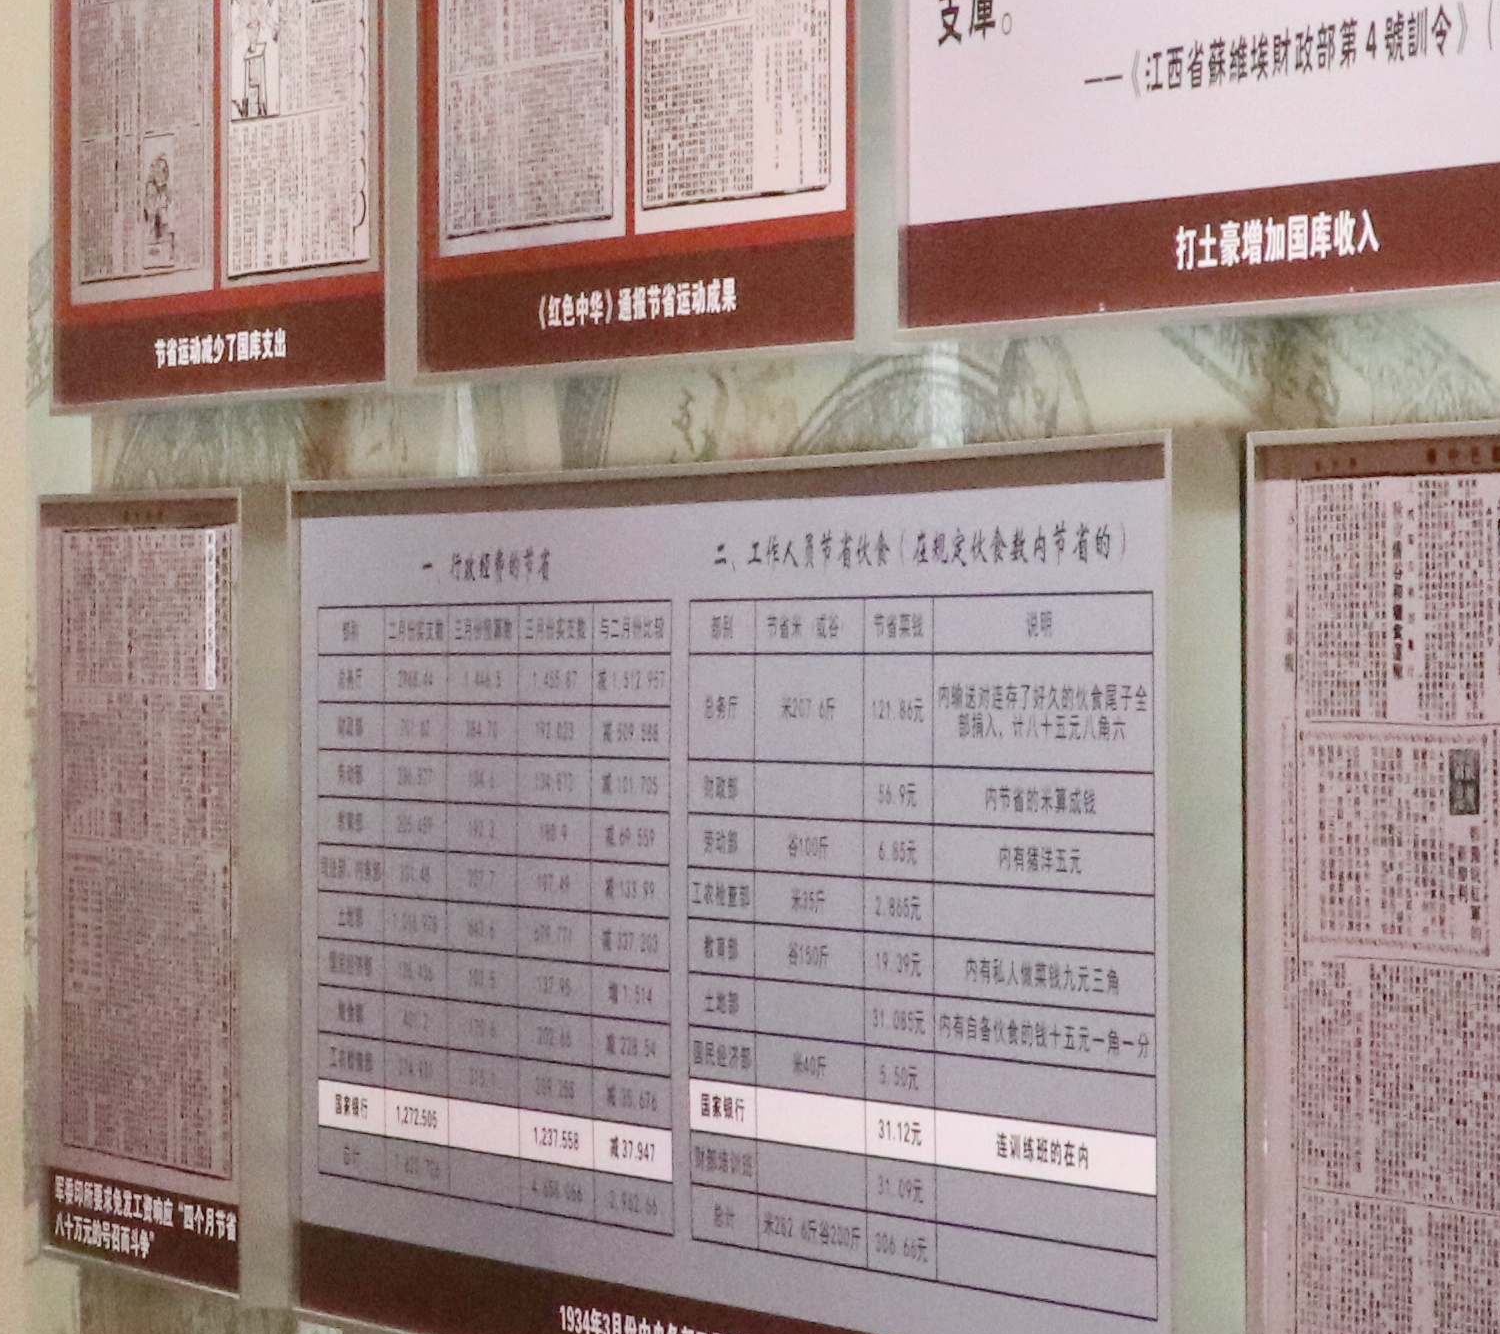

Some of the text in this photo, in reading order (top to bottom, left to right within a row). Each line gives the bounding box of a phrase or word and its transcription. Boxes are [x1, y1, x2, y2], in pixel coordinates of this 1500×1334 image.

[1175, 210, 1380, 272] 打土豪增加国库收入
[538, 277, 736, 328] 《红色中华》通报节省运动成果
[154, 326, 287, 369] 节省运动减少了国库支出
[1026, 611, 1053, 639] 说明
[334, 1093, 368, 1119] 国家银行
[700, 1093, 745, 1122] 国家银行
[877, 1119, 922, 1147] 31.12元
[996, 1132, 1090, 1170] 连训练班的在内
